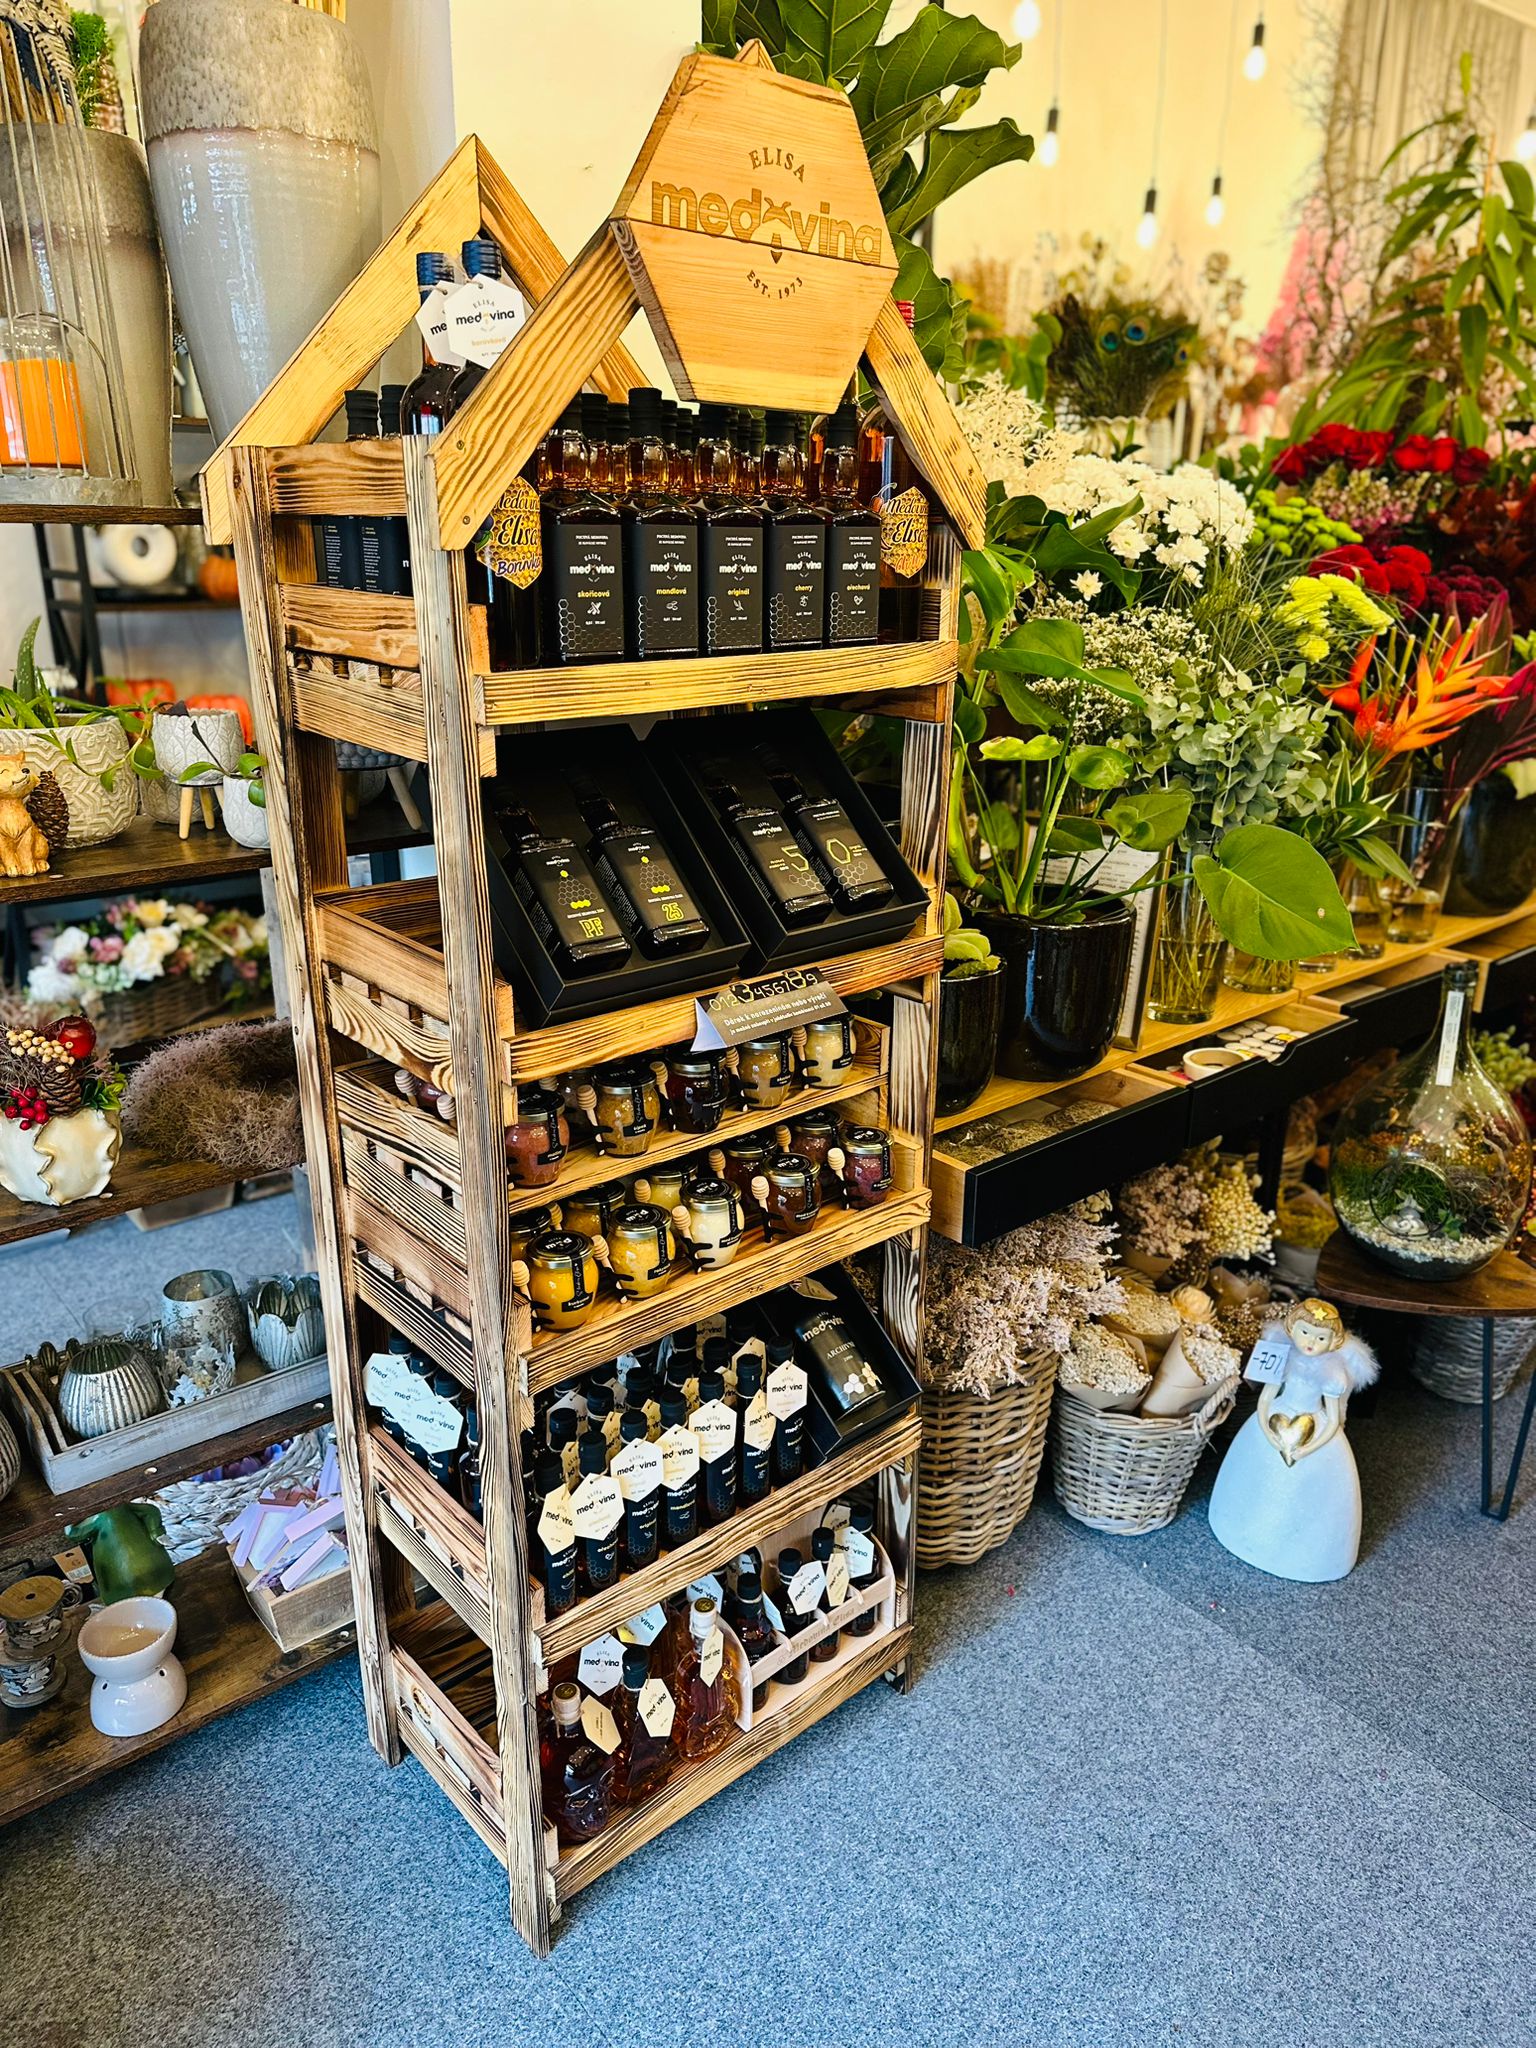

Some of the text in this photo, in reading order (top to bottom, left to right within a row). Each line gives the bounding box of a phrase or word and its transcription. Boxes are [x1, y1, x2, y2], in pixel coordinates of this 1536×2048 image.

[748, 147, 806, 183] ELISA
[746, 269, 804, 300] EST. 1973
[781, 844, 809, 872] 5
[661, 902, 685, 922] 25
[578, 917, 604, 939] PF
